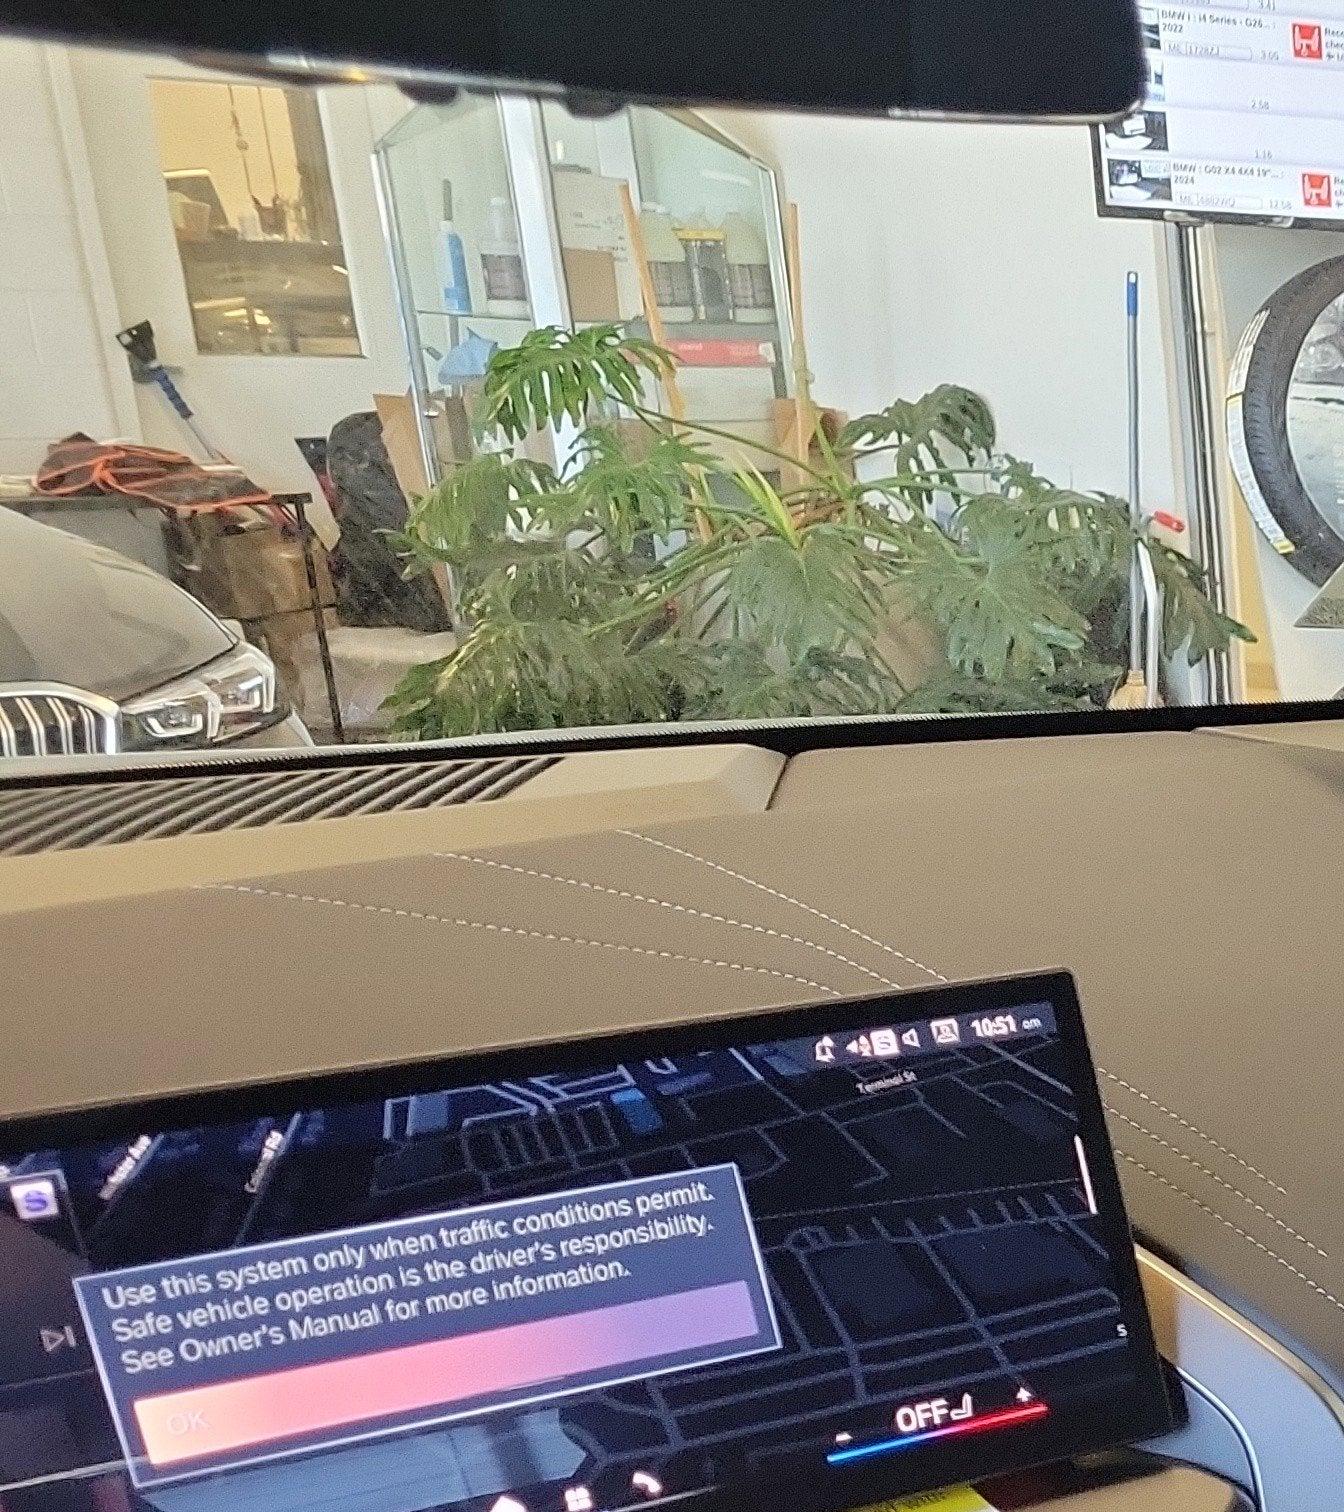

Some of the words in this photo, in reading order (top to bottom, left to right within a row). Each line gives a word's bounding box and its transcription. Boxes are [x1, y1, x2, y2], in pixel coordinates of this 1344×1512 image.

[970, 1014, 1017, 1037] 10:51
[1022, 1017, 1042, 1031] am
[102, 1283, 157, 1310] Use
[161, 1274, 212, 1301] this
[216, 1256, 308, 1293] system
[313, 1243, 367, 1274] only
[367, 1233, 437, 1262] when
[439, 1218, 510, 1248] traffic
[513, 1195, 634, 1236] conditions
[636, 1180, 716, 1218] permit.
[112, 1312, 174, 1343] Safe
[175, 1294, 271, 1330] vehicle
[274, 1272, 395, 1312] operation
[400, 1264, 423, 1287] is
[424, 1257, 468, 1284] the
[470, 1241, 556, 1274] driver's
[559, 1213, 715, 1257] responsibility.
[121, 1347, 175, 1375] See
[179, 1324, 286, 1363] Owner's
[288, 1302, 382, 1341] Manual
[384, 1296, 420, 1323] for
[424, 1283, 491, 1315] more
[492, 1259, 633, 1301] information.
[166, 1407, 211, 1436] OK
[895, 1398, 949, 1433] OFF
